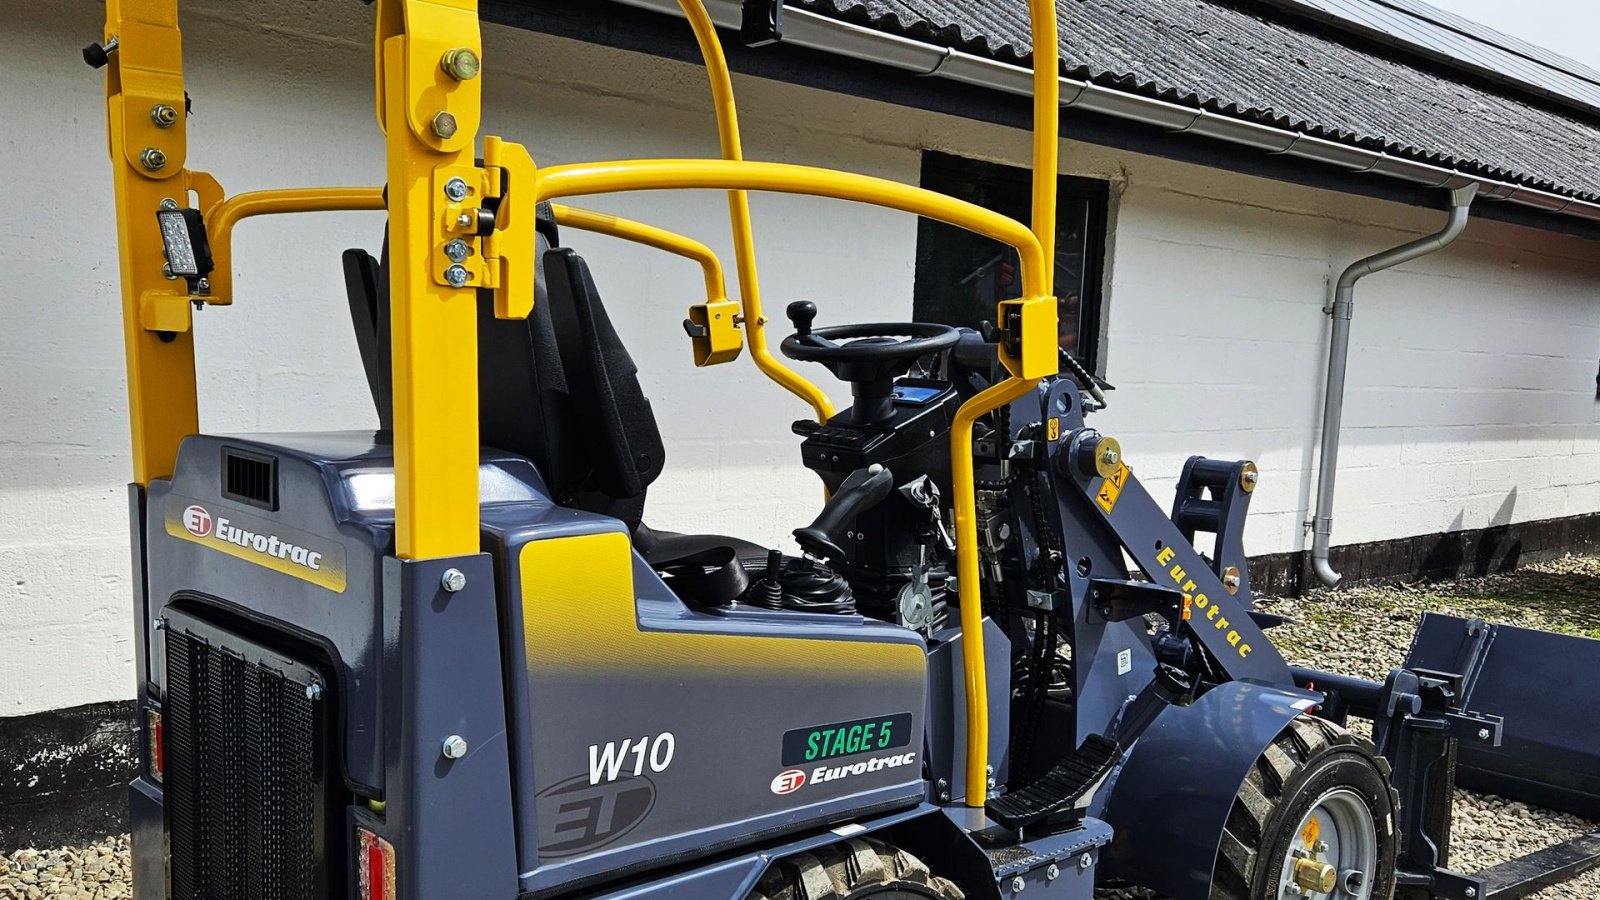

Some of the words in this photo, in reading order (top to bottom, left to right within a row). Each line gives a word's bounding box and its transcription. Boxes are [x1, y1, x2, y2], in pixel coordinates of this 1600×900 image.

[183, 505, 212, 536] ET
[215, 517, 322, 570] Eurotrac
[1156, 547, 1252, 658] Eurotrac
[589, 732, 675, 785] W10
[805, 724, 875, 760] STAGE
[878, 721, 893, 748] 5
[771, 770, 805, 795] ET
[810, 752, 916, 785] Eurotrac
[537, 776, 653, 851] ET
